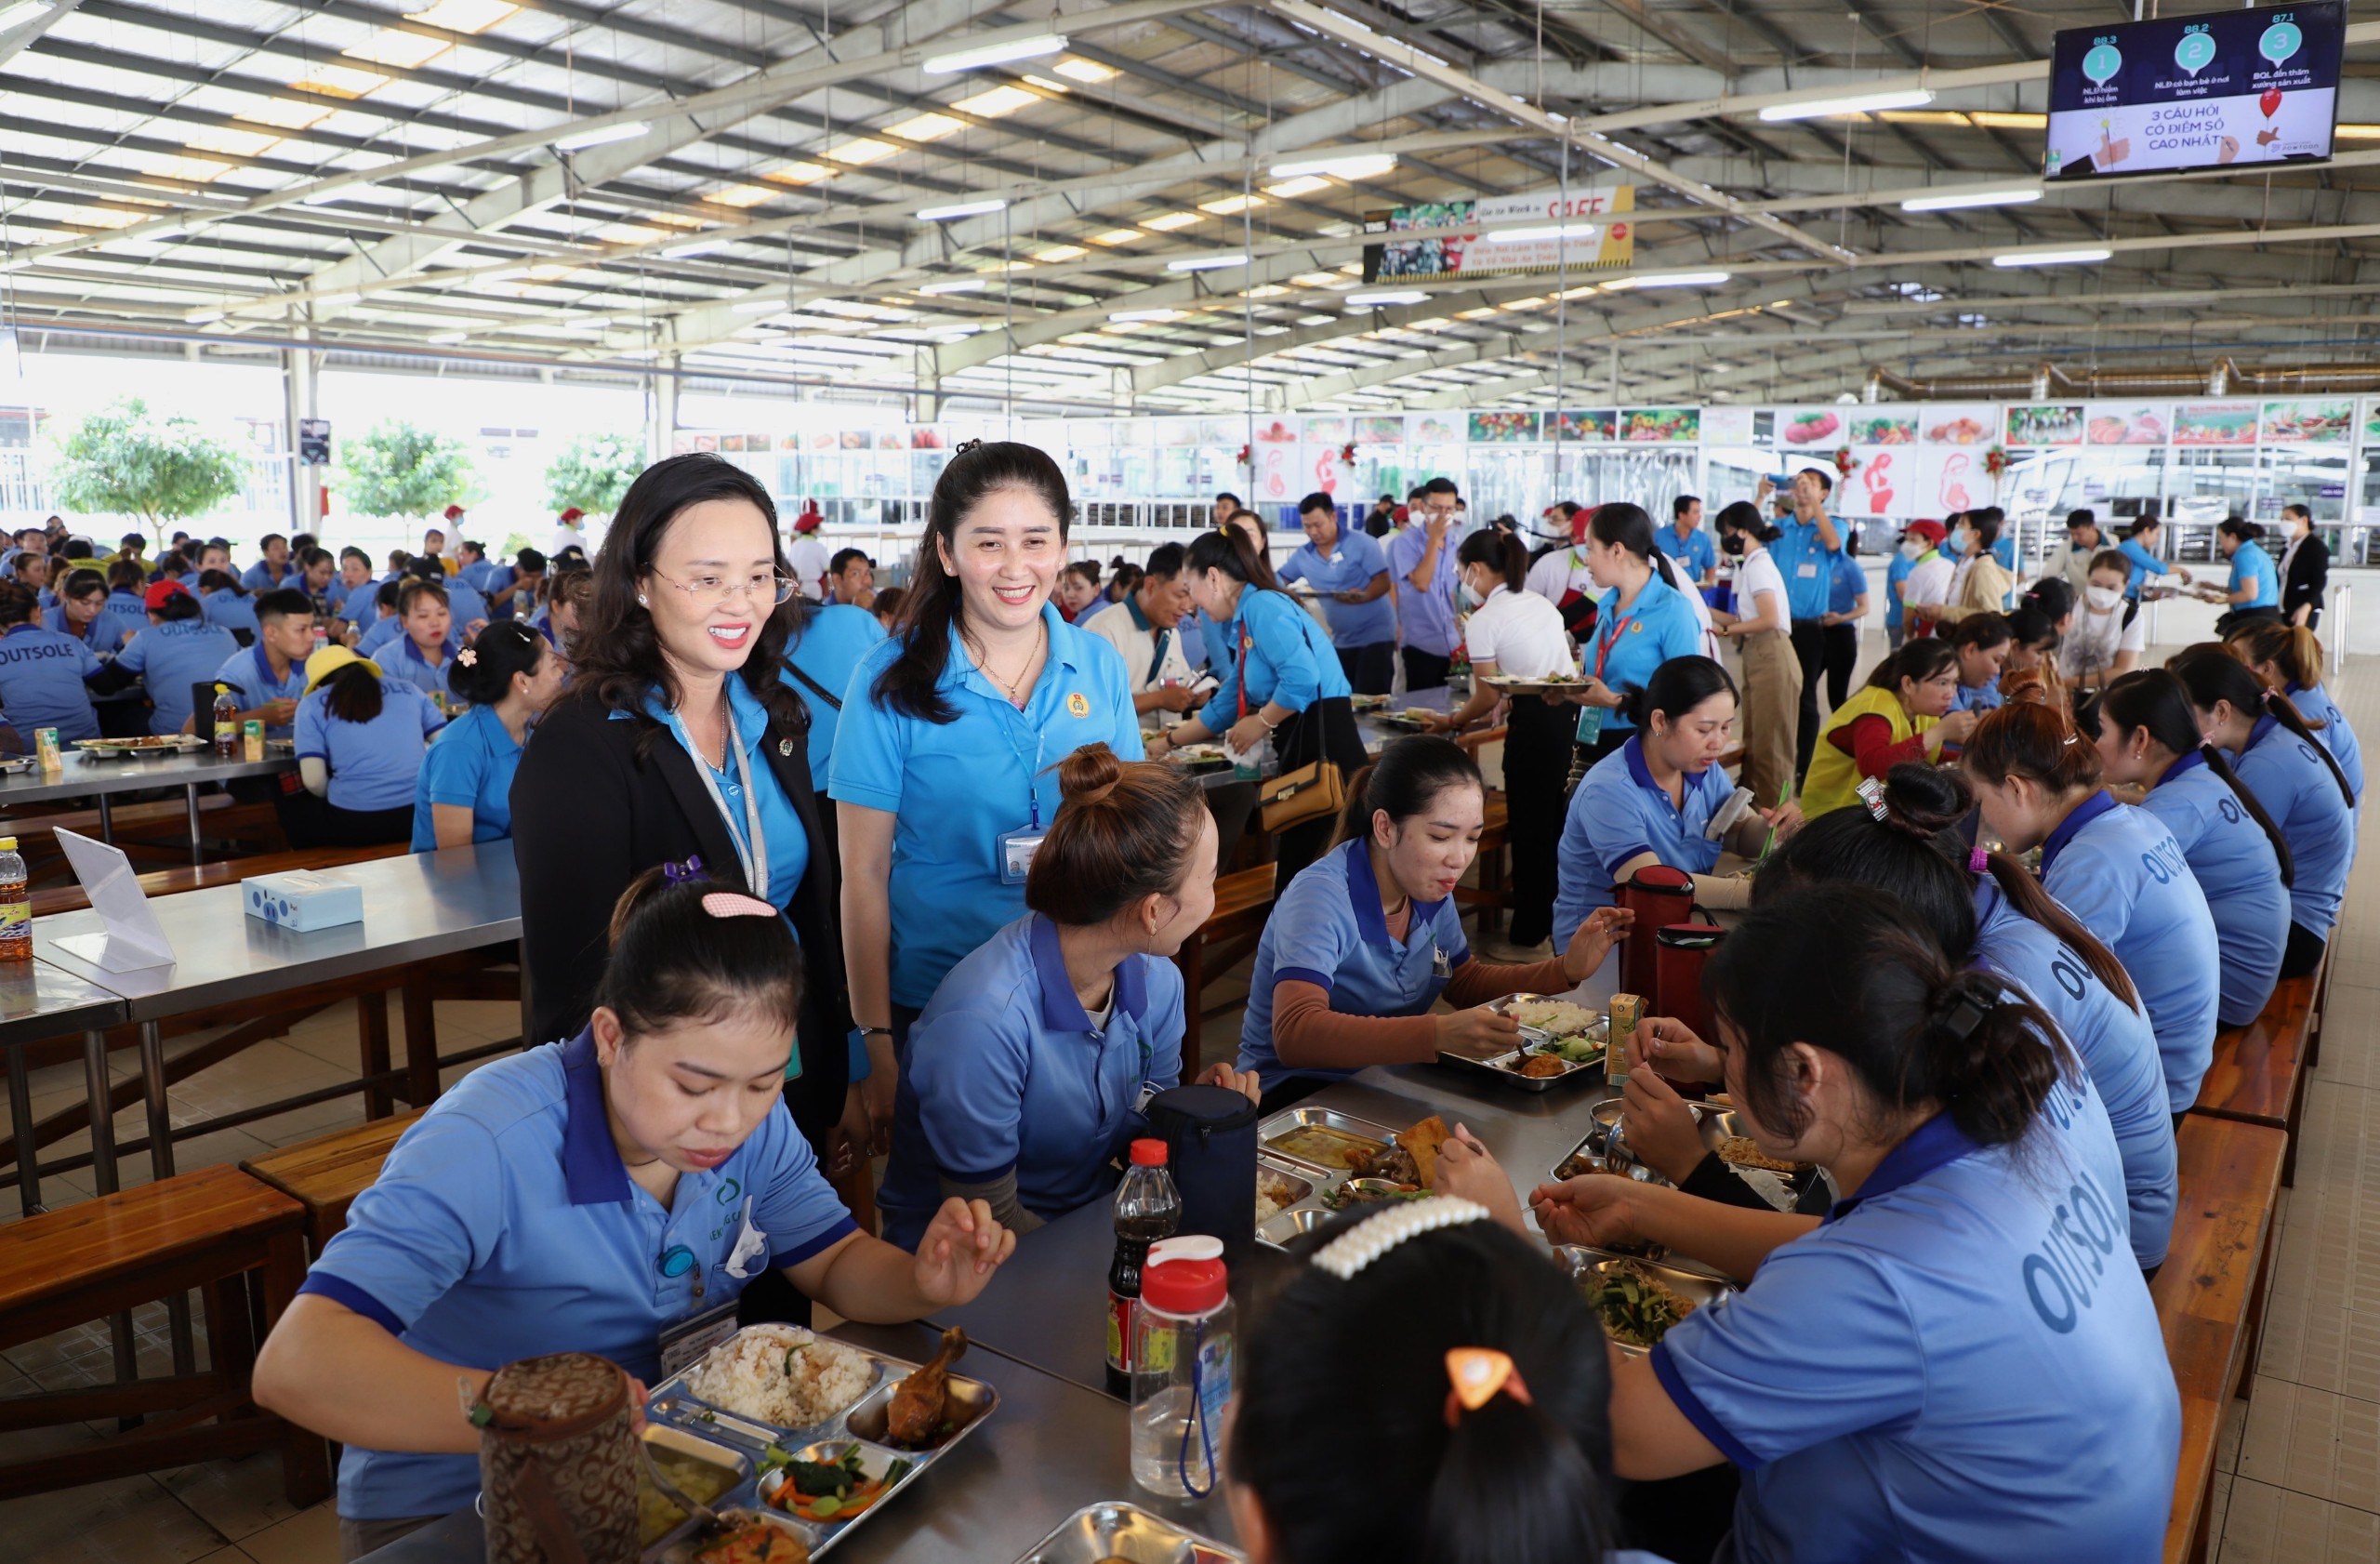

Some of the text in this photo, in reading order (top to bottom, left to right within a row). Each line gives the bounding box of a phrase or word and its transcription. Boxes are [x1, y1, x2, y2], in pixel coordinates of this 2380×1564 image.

[2184, 23, 2209, 33] 88.2
[2273, 33, 2288, 49] 3
[2188, 43, 2202, 59] 2
[2097, 54, 2106, 71] 1
[2152, 103, 2219, 121] 3 CÂU HỎI
[2145, 122, 2165, 136] CÓ
[2149, 138, 2178, 150] CAO
[0, 643, 74, 667] OUTSOLE
